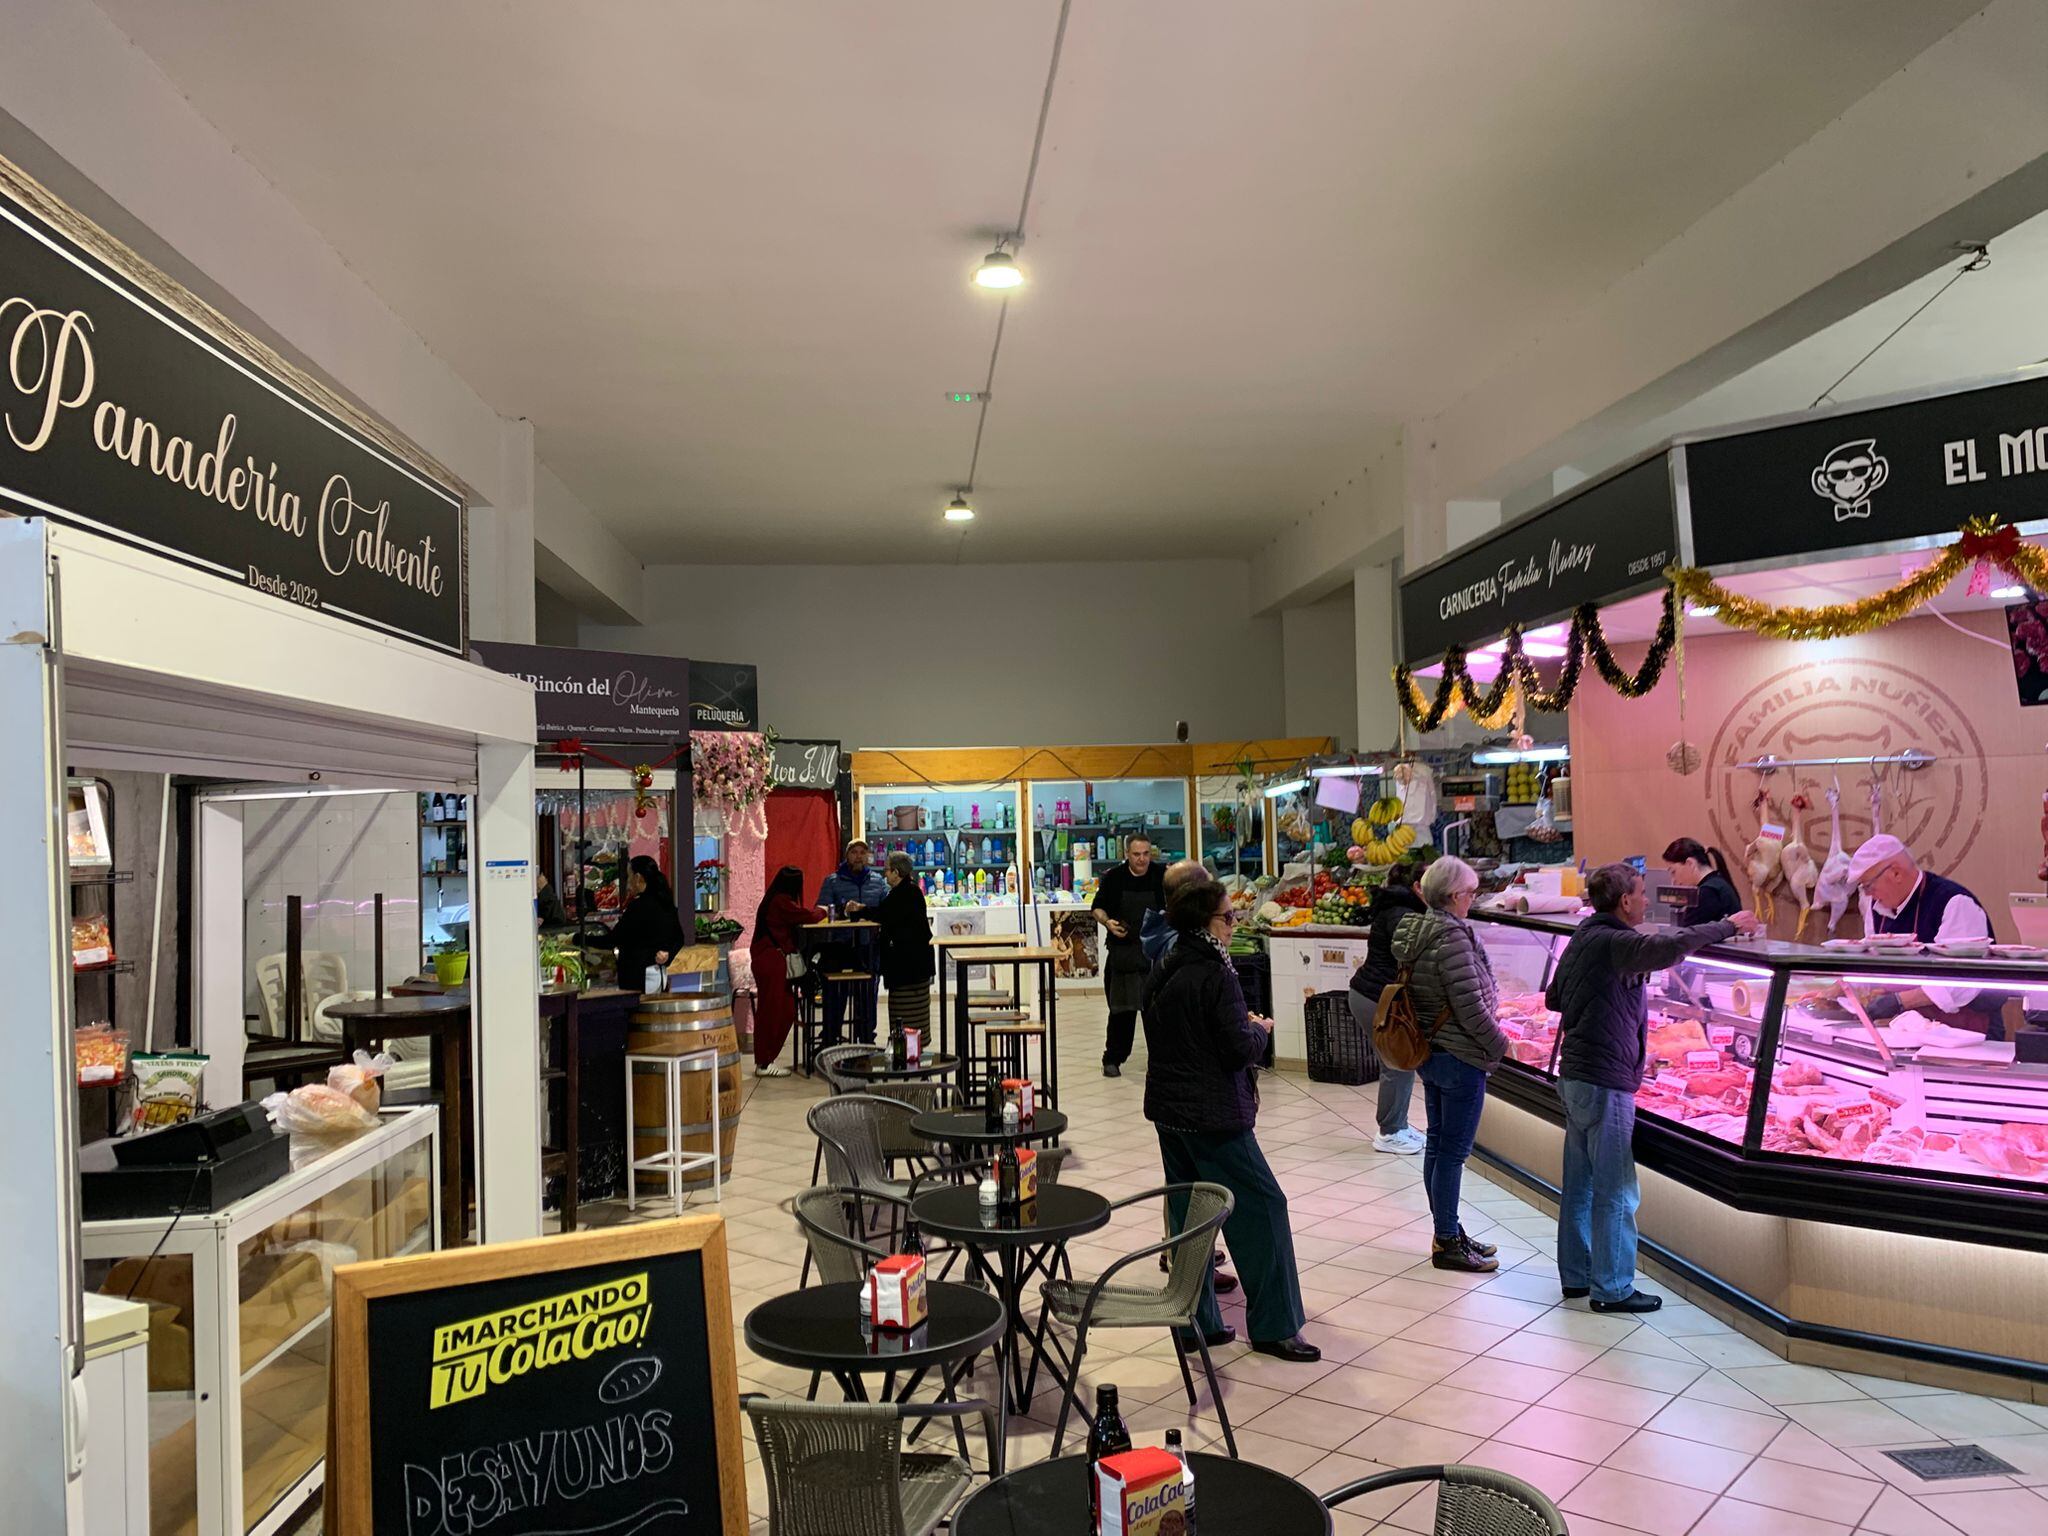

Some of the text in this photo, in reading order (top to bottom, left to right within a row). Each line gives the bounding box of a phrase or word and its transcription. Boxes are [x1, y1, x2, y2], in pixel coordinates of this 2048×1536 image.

[0, 297, 443, 597] Panadería Calvente
[1944, 438, 1987, 486] EL
[248, 564, 319, 608] Desde 2022
[1439, 576, 1498, 620] CARNICERIA
[1497, 558, 1543, 607] Familia
[1628, 556, 1650, 576] DESDE
[586, 677, 611, 696] del
[629, 703, 680, 719] Mantequería
[696, 708, 745, 722] PELUQUERÍA
[1725, 675, 1965, 766] FAMILIA NUÑEZ
[441, 1281, 641, 1354] ¡MARCHANDO
[404, 1409, 673, 1536] DESAYUNOS
[1127, 1481, 1185, 1525] ColaCao
